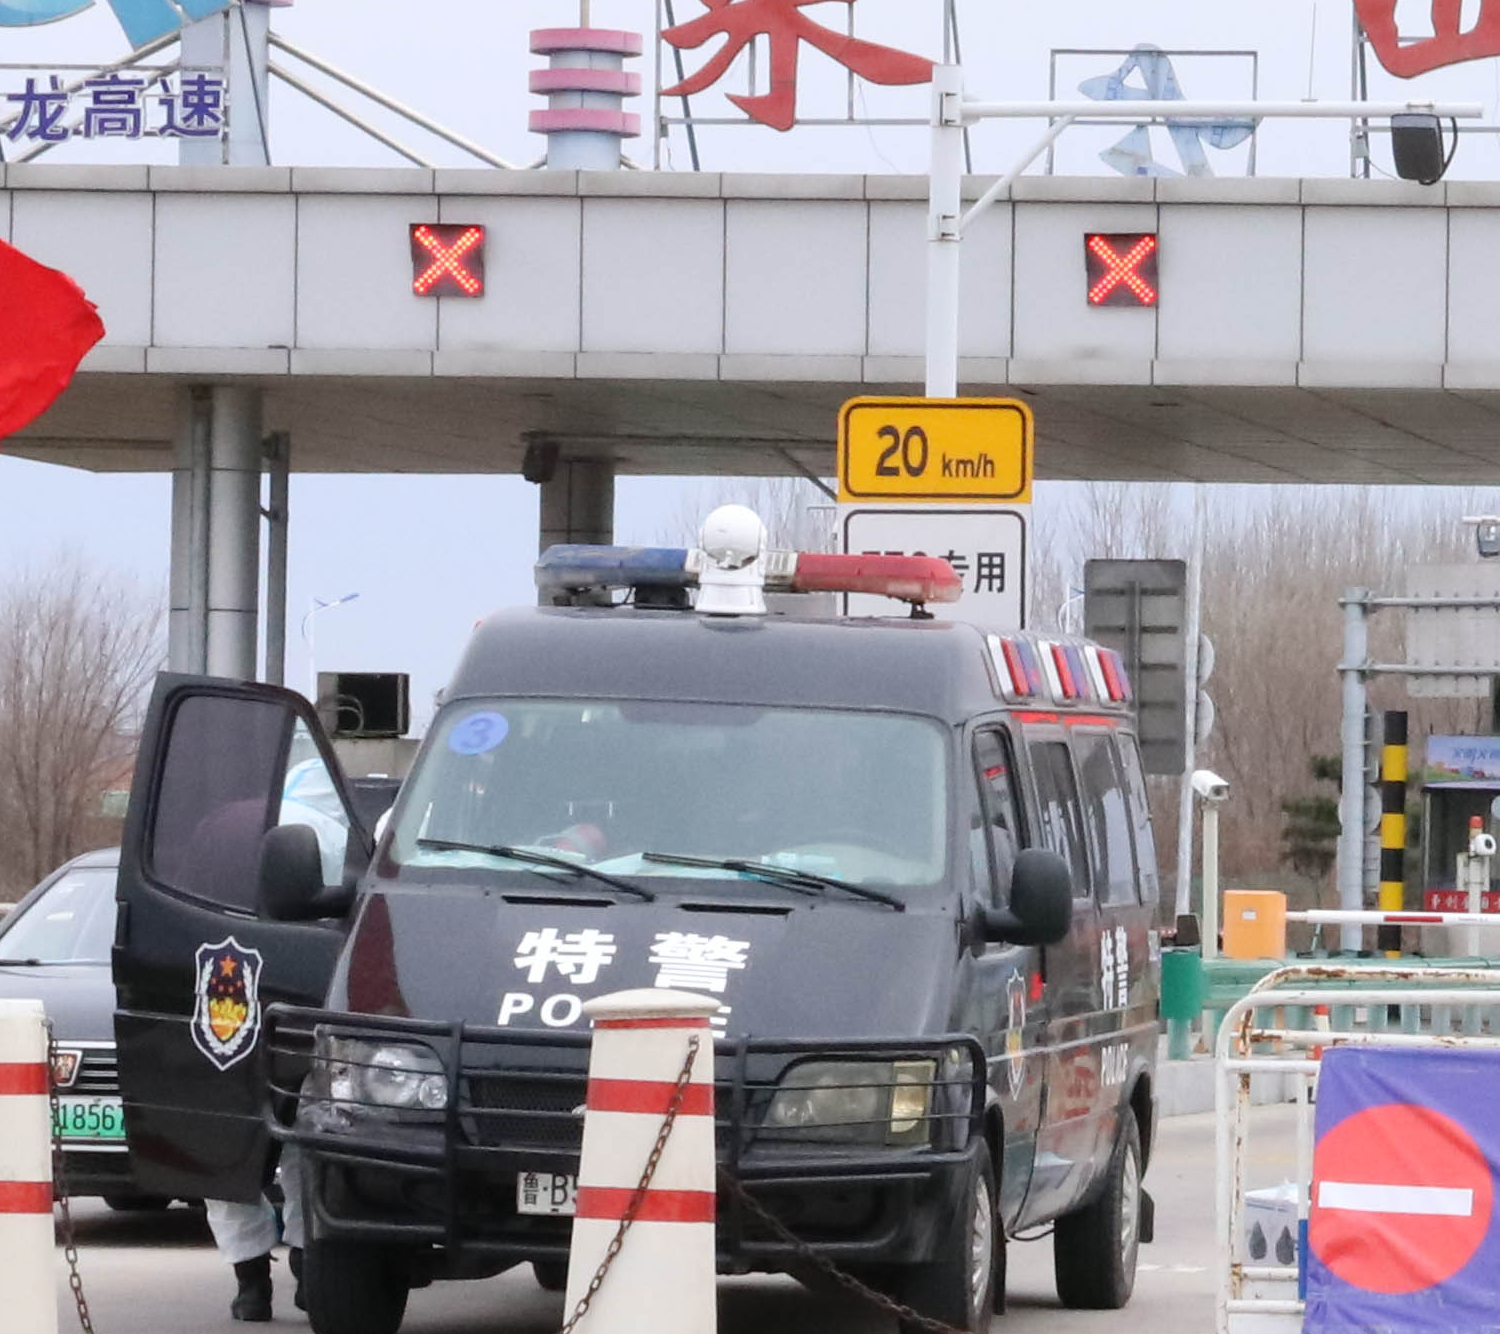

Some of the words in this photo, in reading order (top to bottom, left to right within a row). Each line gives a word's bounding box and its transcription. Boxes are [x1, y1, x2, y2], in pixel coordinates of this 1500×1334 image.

[875, 424, 929, 478] 20
[941, 452, 996, 478] km/h
[513, 927, 751, 993] 特警
